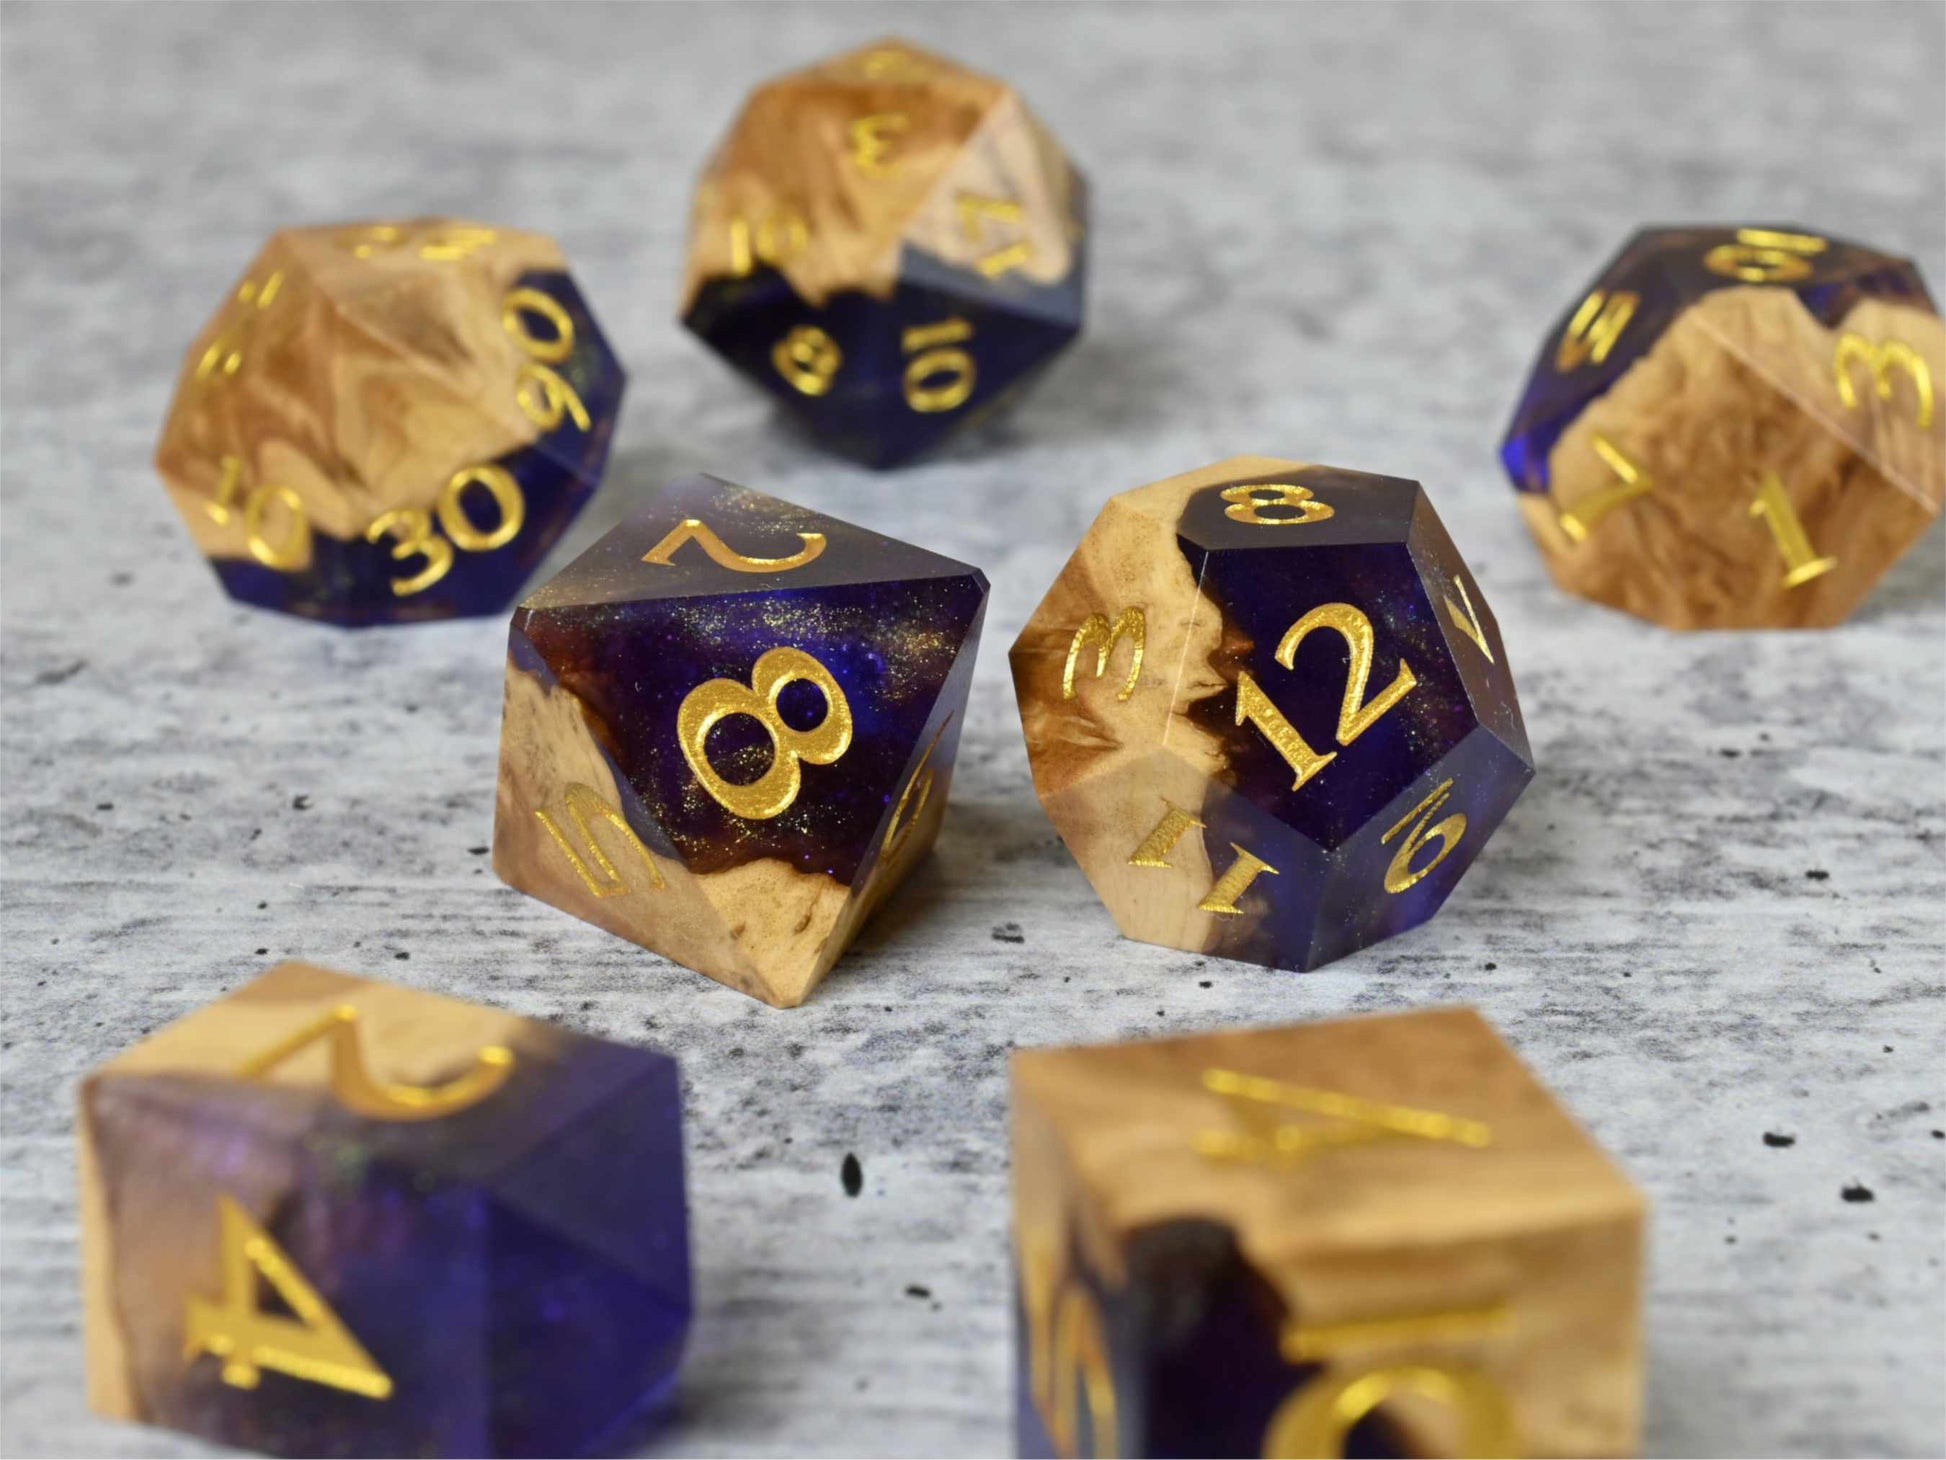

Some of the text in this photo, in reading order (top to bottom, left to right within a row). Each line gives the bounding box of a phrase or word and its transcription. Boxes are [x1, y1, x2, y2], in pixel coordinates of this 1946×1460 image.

[902, 316, 977, 413] 10
[1834, 332, 1934, 431] 3
[366, 464, 525, 597] 30
[641, 518, 827, 574] 2
[1220, 483, 1336, 526] 8
[1748, 470, 1838, 589] 1
[1062, 605, 1147, 701] 3
[1235, 601, 1418, 793] 12
[677, 646, 853, 820] 8
[1127, 797, 1280, 915] 11
[228, 1002, 516, 1122] 2
[182, 1192, 394, 1400] 4
